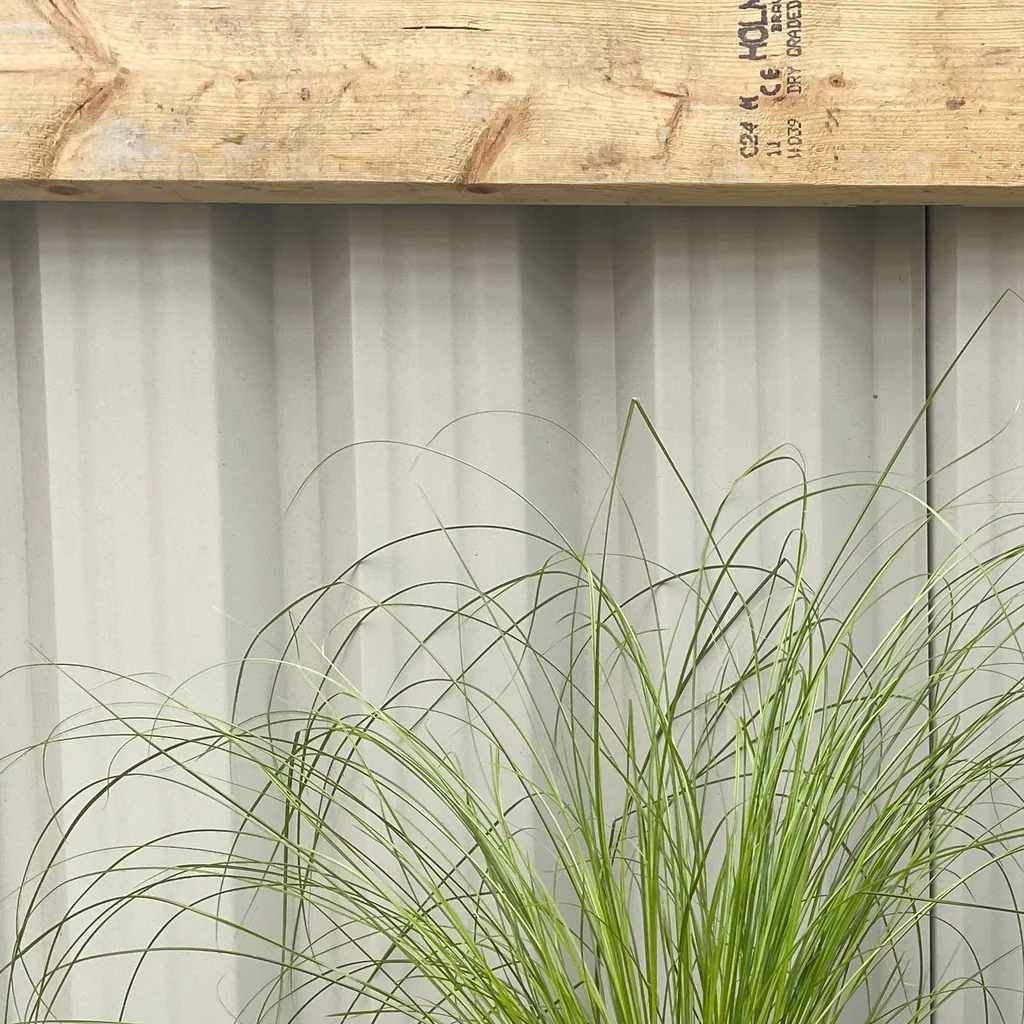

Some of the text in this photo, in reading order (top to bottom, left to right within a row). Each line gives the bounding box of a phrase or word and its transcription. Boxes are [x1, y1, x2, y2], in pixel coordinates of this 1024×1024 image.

[786, 0, 802, 57] GRADED
[787, 66, 802, 94] DRY
[739, 121, 759, 159] C24
